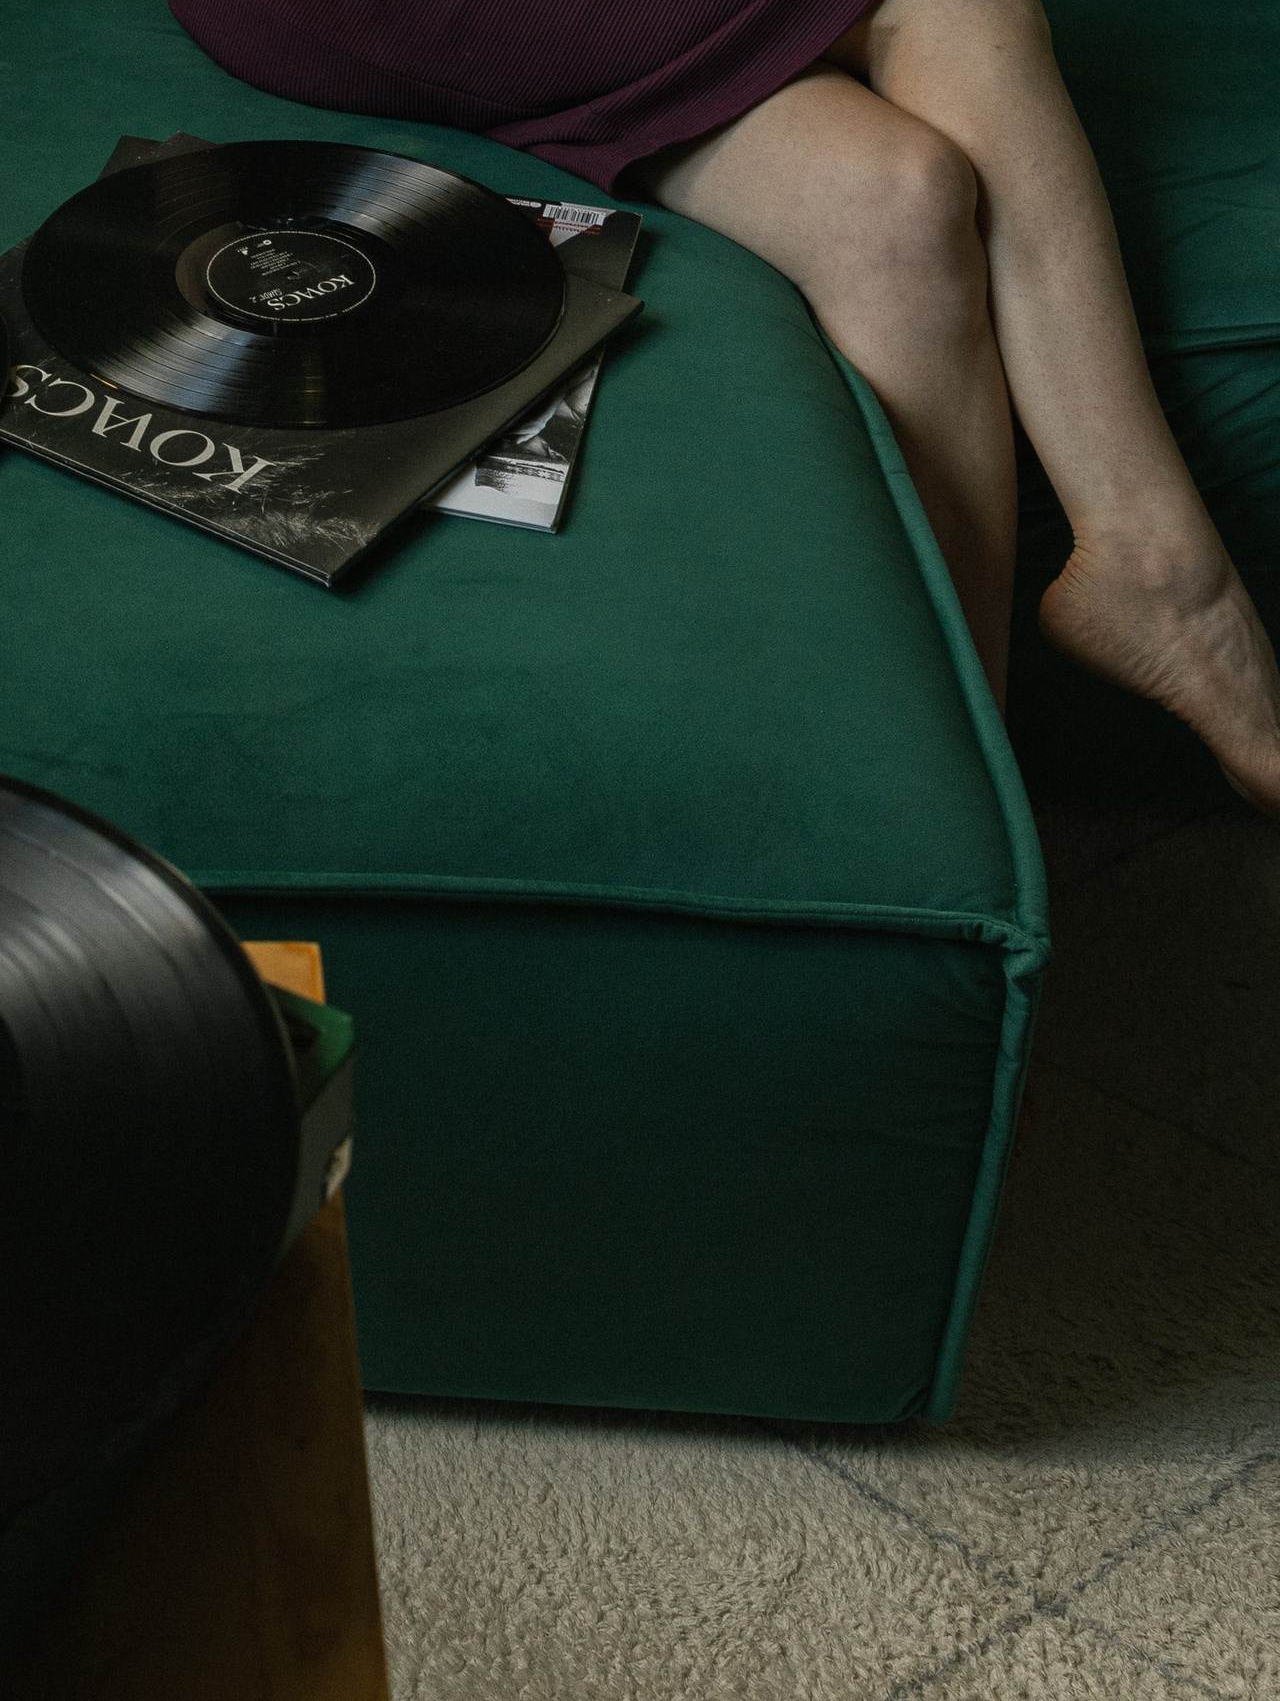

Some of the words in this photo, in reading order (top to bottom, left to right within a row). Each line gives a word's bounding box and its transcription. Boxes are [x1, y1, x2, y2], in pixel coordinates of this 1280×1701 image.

[259, 288, 282, 301] SHADE
[267, 274, 355, 311] KOVACS
[4, 364, 275, 494] KOVACS
